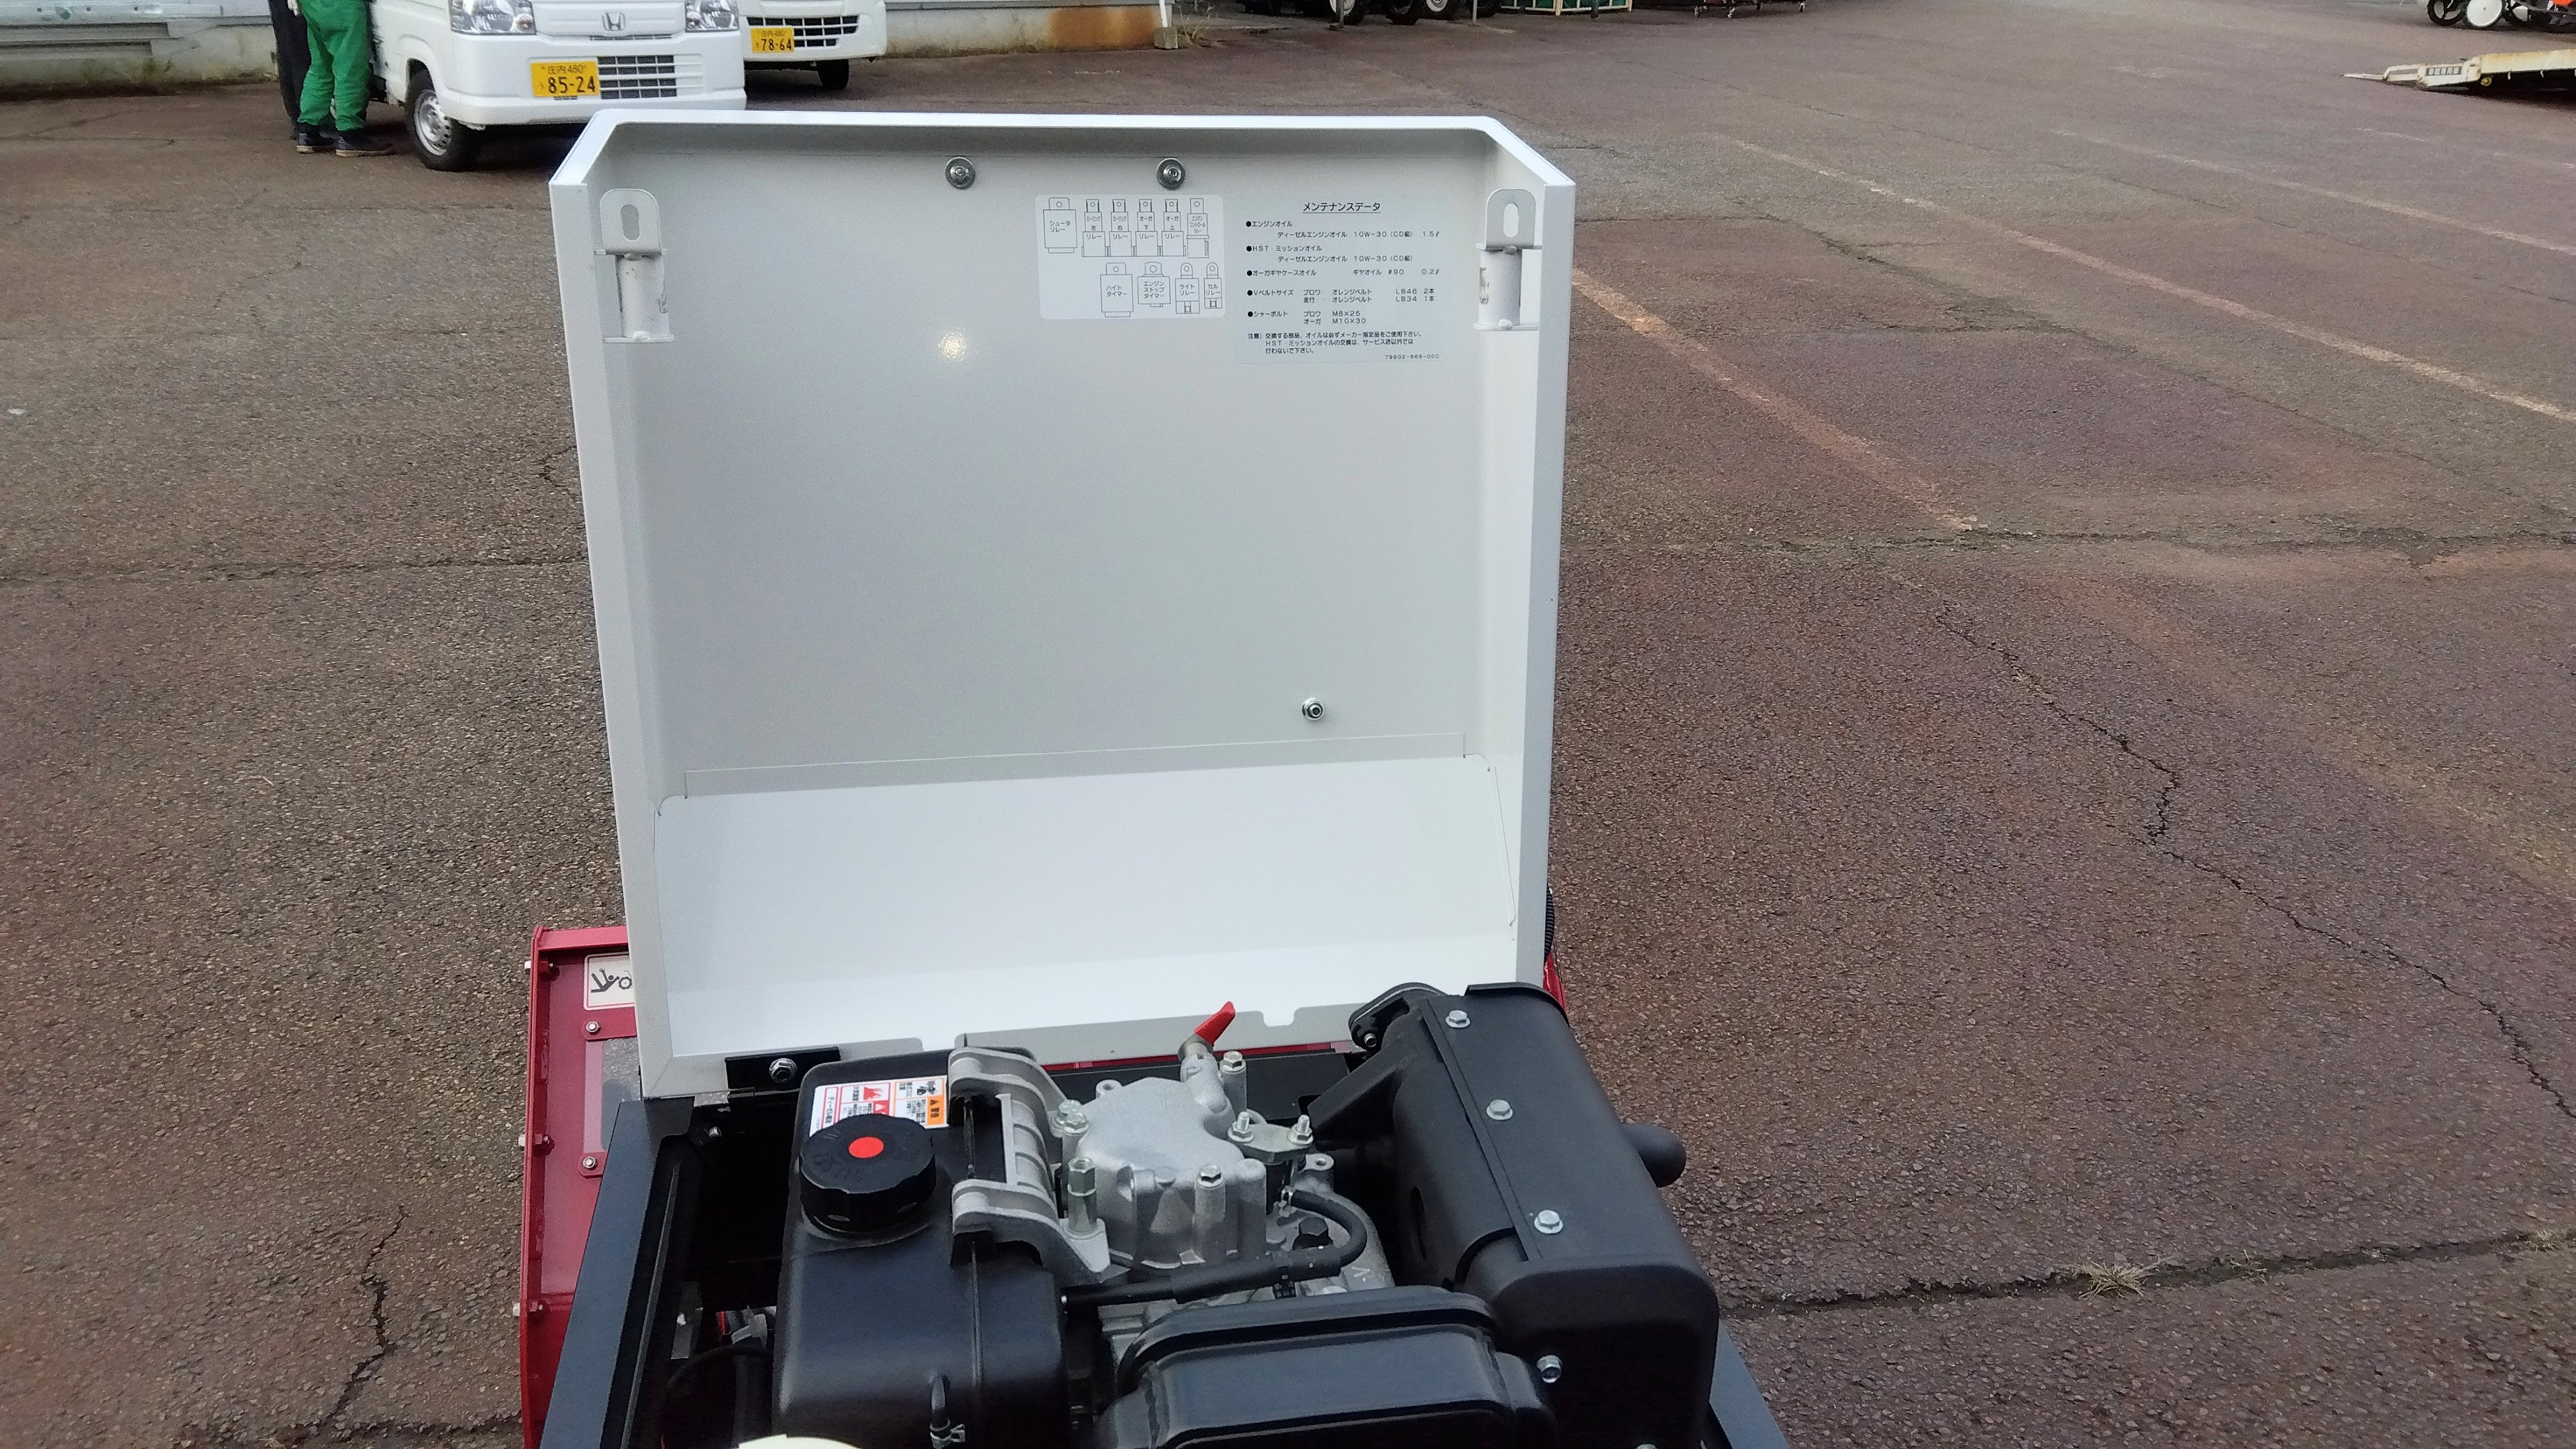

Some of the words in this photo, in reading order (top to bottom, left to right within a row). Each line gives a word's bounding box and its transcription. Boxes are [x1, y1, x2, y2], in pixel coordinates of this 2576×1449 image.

[761, 38, 792, 51] 78-64
[548, 76, 595, 93] 85-24
[1303, 203, 1381, 211] メンテナンスデータ
